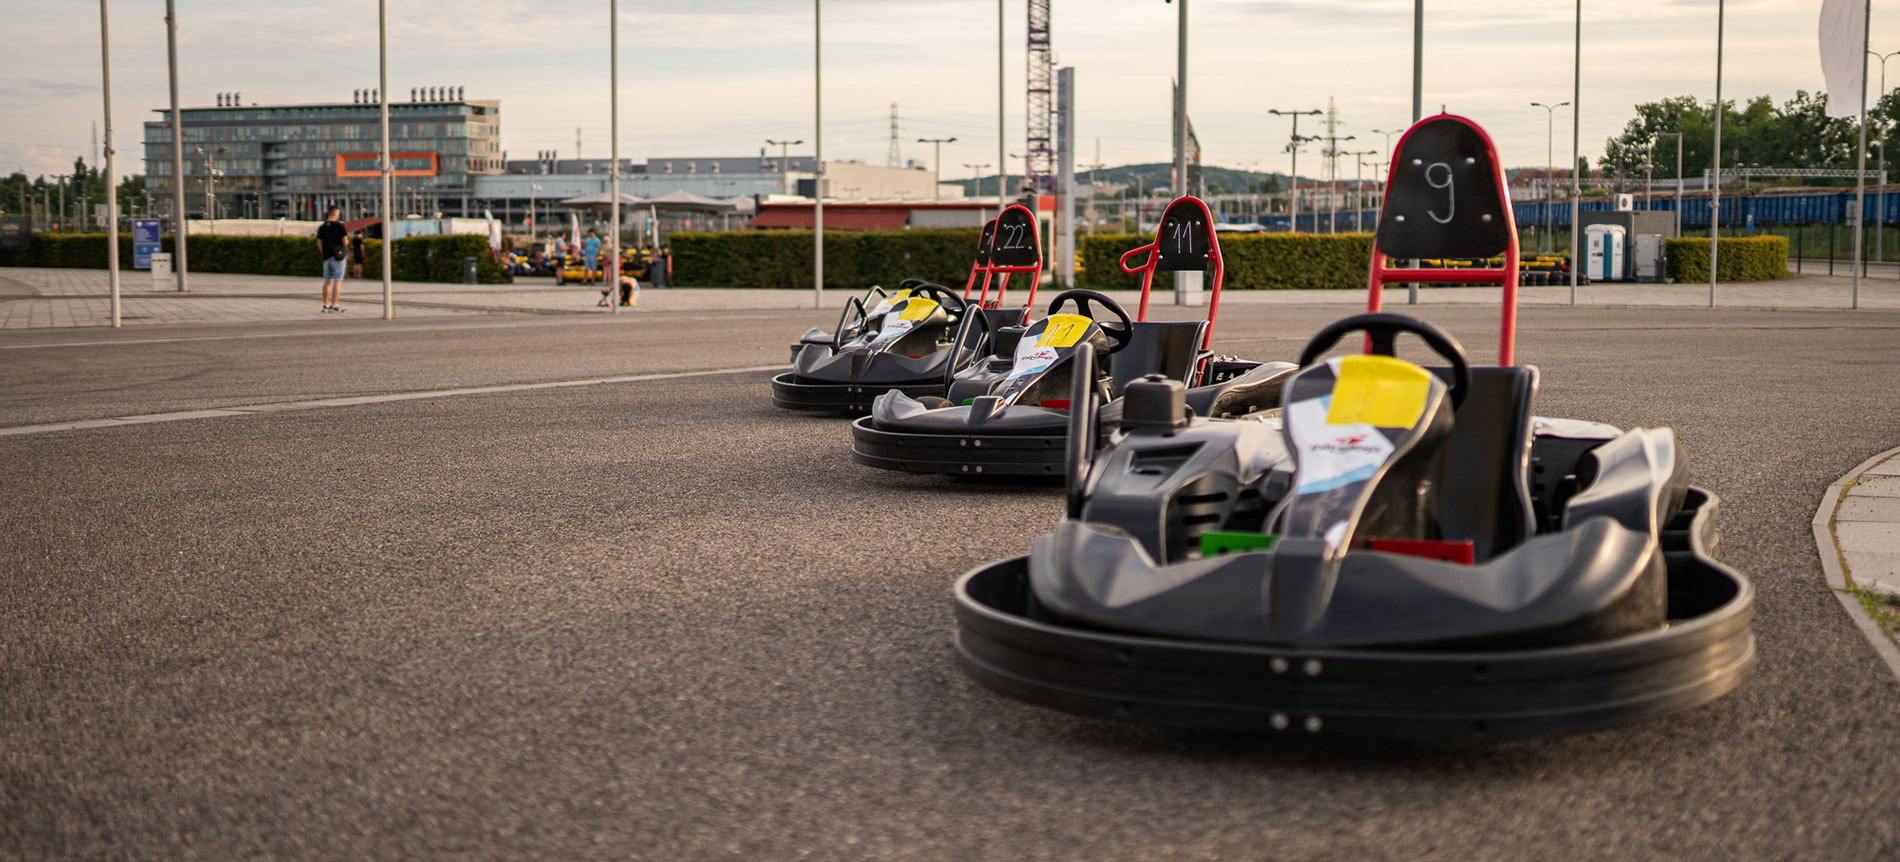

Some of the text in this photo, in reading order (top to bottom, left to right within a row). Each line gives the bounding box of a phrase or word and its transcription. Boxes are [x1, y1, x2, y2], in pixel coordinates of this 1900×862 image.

[1424, 162, 1455, 224] 9
[1003, 225, 1025, 249] 22
[1173, 220, 1193, 254] 11
